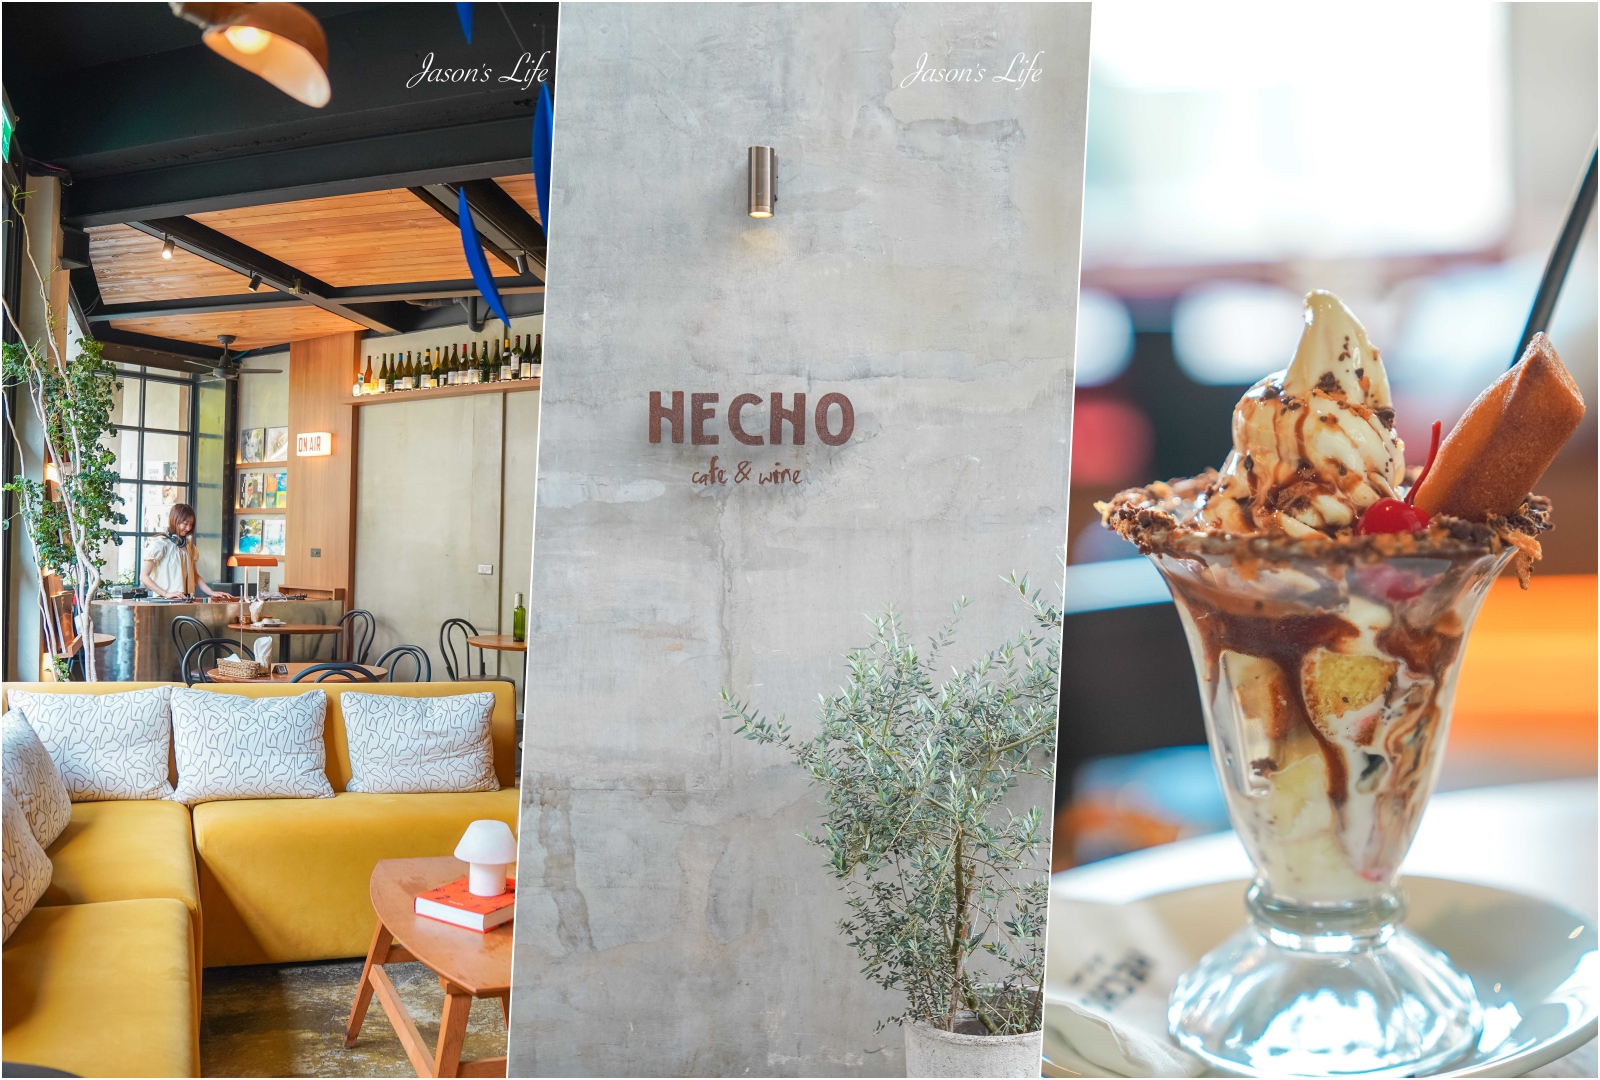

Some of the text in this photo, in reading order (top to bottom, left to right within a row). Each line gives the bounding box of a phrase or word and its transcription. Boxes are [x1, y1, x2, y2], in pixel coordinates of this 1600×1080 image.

[648, 390, 855, 447] HECHO
[298, 436, 322, 453] ON AIR
[691, 455, 803, 487] cafe & wine
